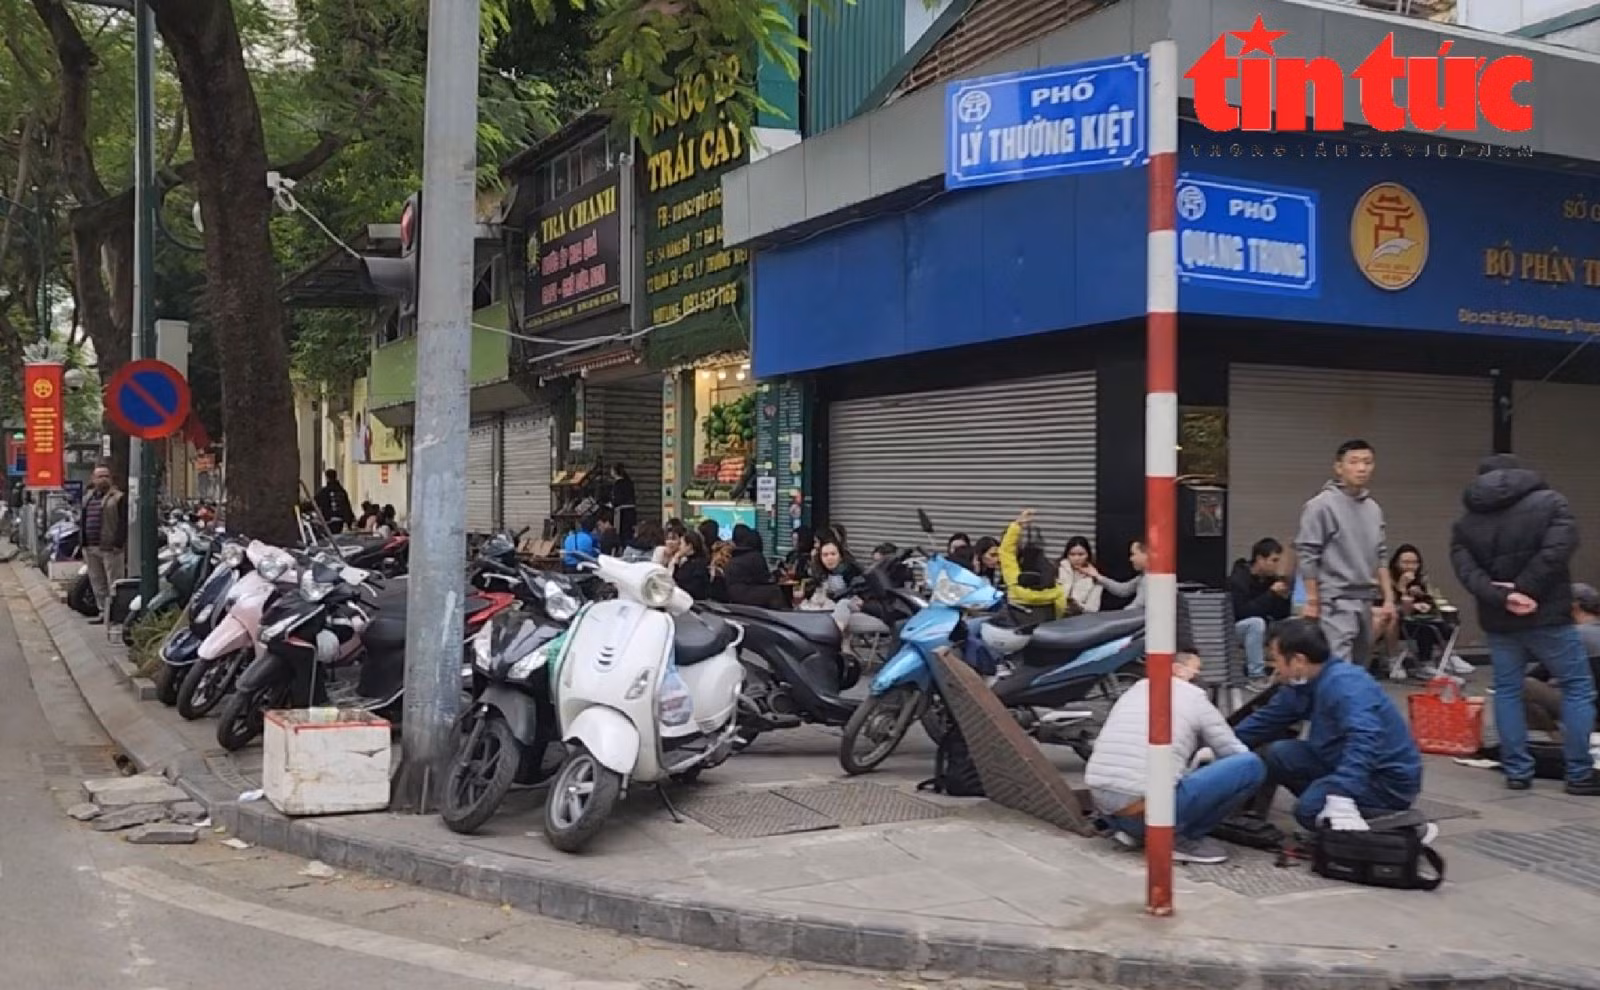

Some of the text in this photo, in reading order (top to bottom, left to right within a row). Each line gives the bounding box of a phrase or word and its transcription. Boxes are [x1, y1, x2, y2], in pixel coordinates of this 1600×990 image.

[1031, 74, 1098, 107] PHỐ
[960, 104, 1135, 167] LÝ THƯỜNG KIỆT
[648, 132, 695, 191] TRÁI
[541, 206, 566, 243] TRÀ
[1229, 197, 1279, 222] PHỐ
[1181, 229, 1306, 279] QUANG TRUNG
[1484, 240, 1515, 286] BỘ
[1520, 246, 1576, 288] PHẬN
